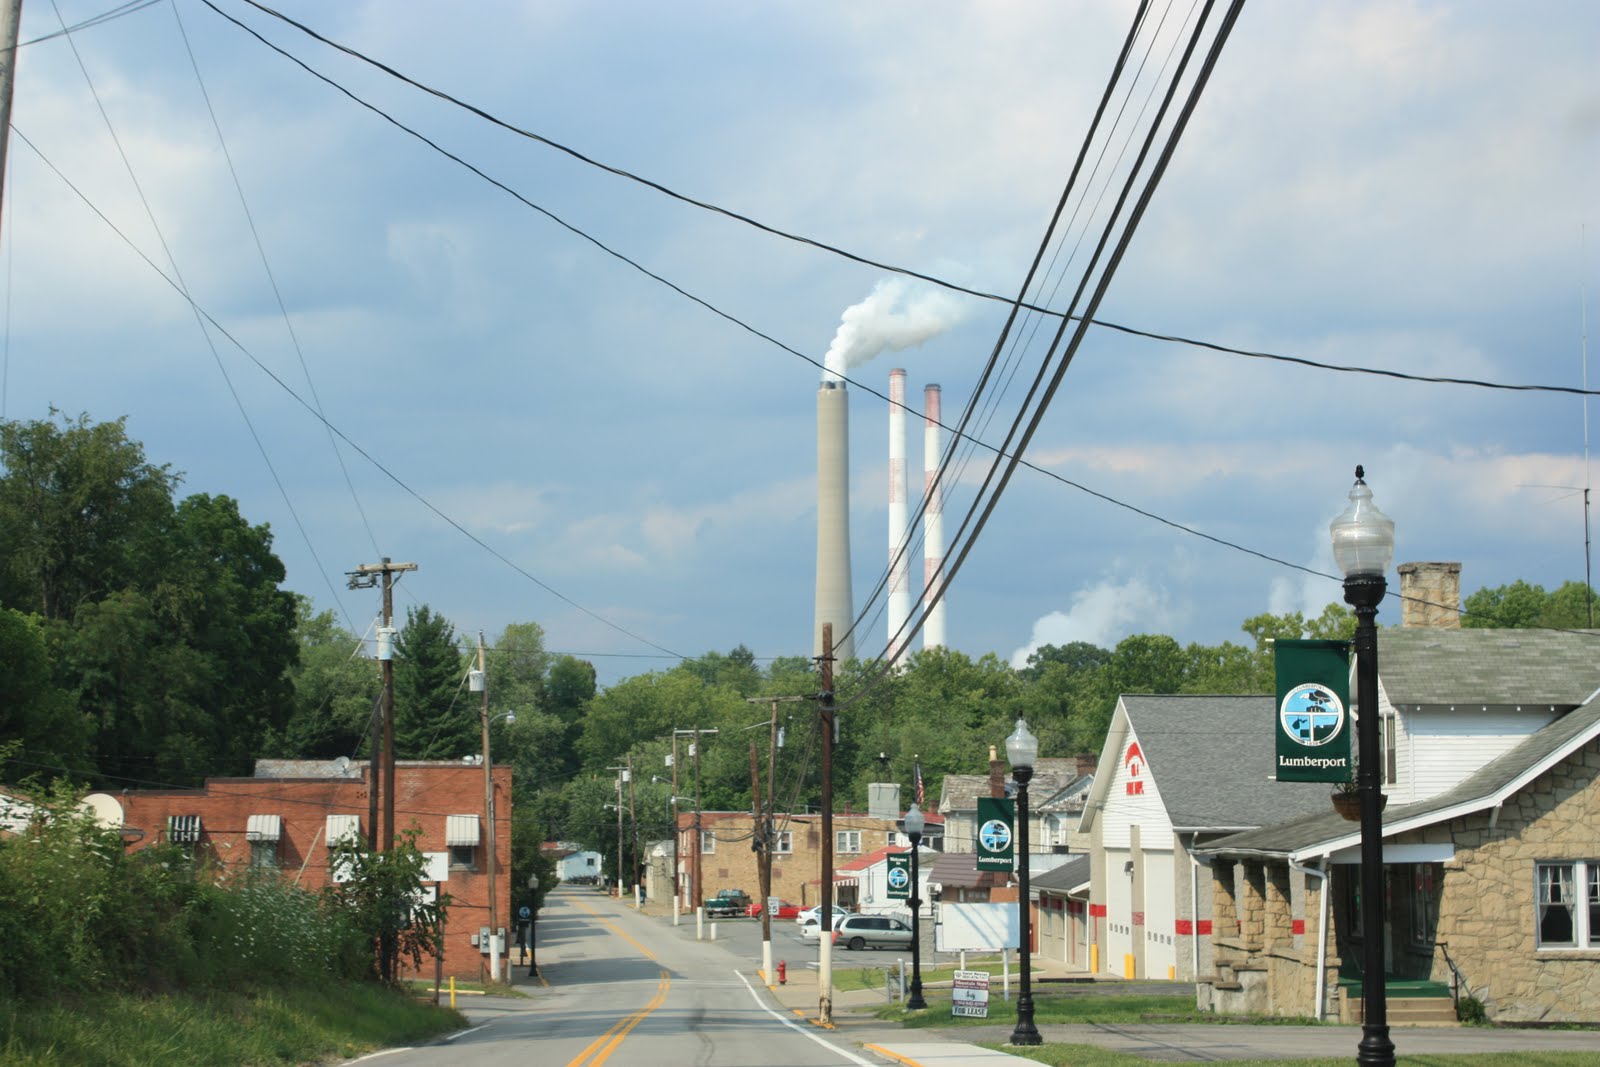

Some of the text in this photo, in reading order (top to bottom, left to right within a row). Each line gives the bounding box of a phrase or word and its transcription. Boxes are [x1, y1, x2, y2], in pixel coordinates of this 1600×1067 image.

[1279, 755, 1346, 768] Lumberport
[978, 856, 1012, 864] Lumberport
[954, 1006, 986, 1015] FOR LEASE
